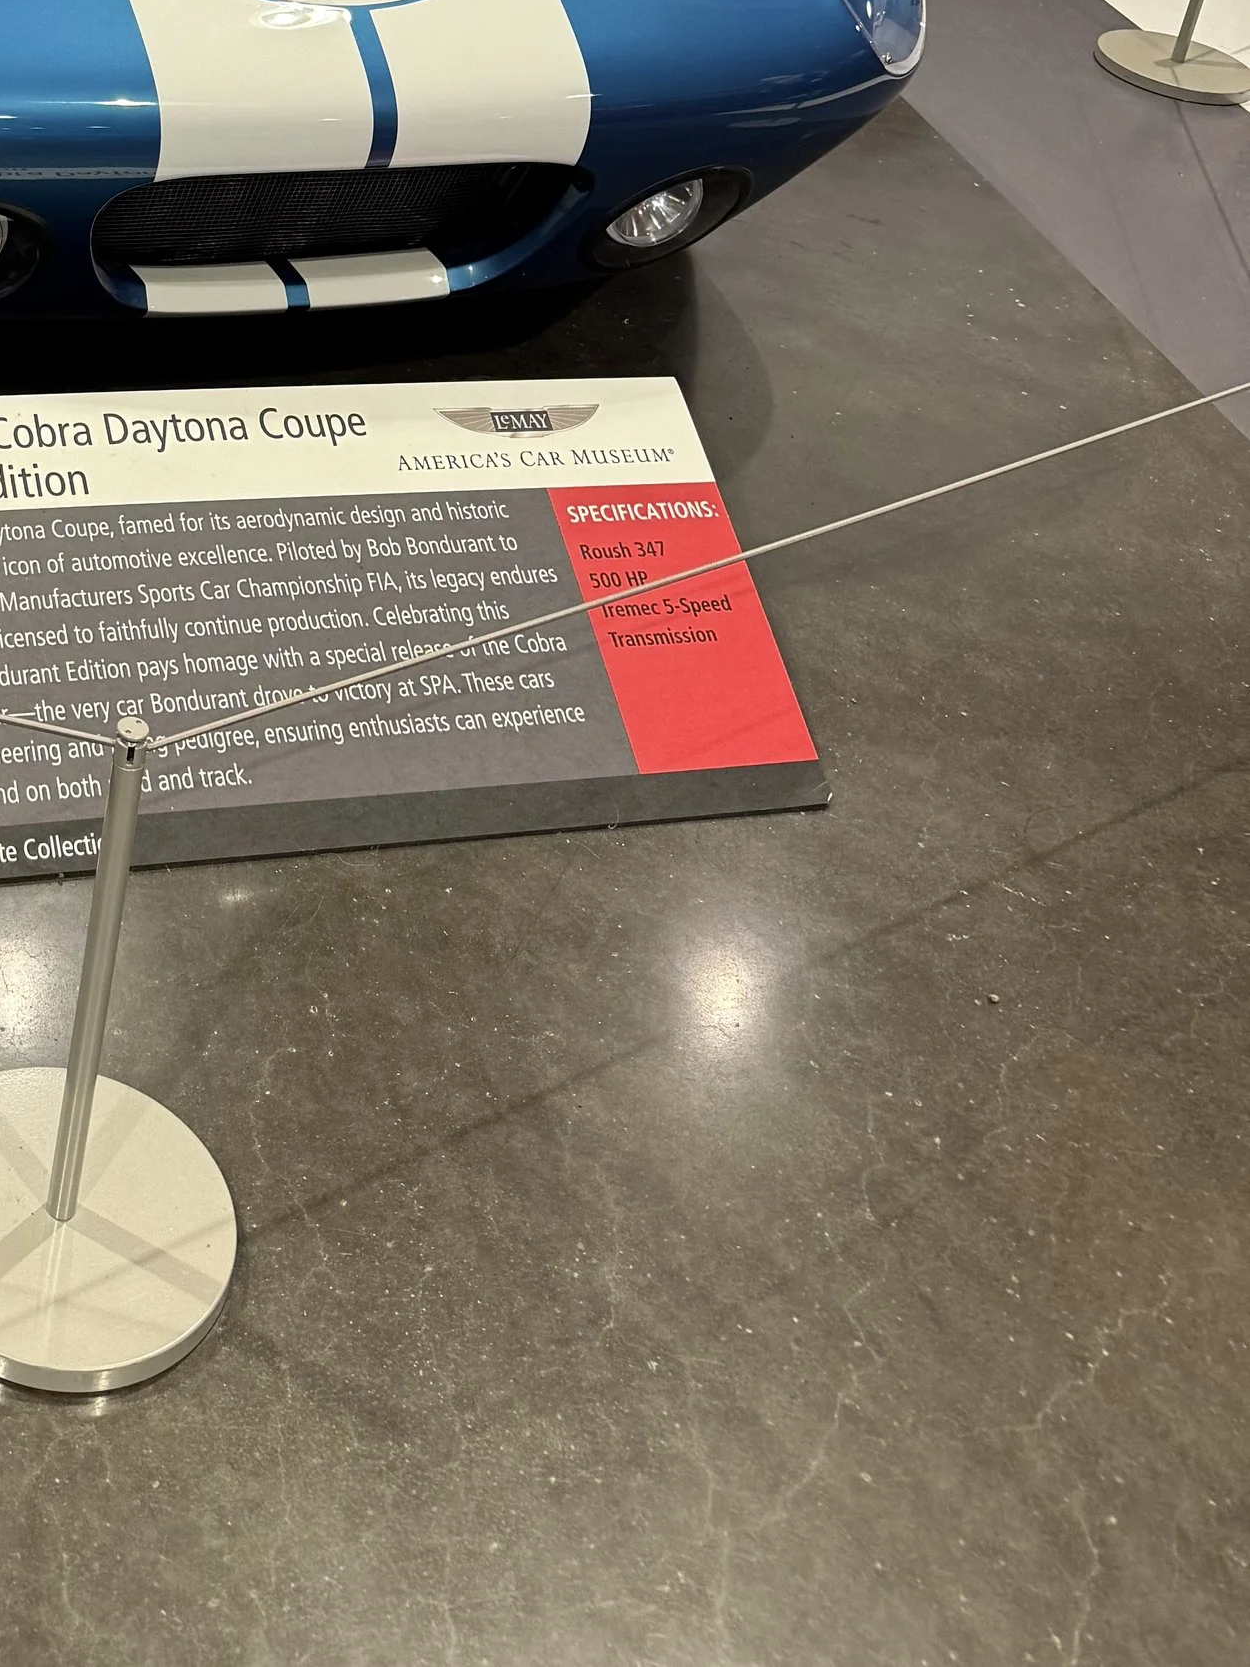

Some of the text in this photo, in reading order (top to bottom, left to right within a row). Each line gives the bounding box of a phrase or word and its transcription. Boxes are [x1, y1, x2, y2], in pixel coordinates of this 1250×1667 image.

[102, 412, 250, 454] Daytona
[258, 406, 368, 447] Coupe
[519, 450, 566, 468] CAR
[50, 518, 115, 543] Coupe,
[117, 512, 176, 536] famed
[178, 511, 205, 533] for
[208, 511, 232, 531] its
[235, 506, 348, 533] aerodynamic
[349, 503, 407, 529] design
[410, 500, 444, 523] and
[444, 499, 511, 521] historic
[566, 500, 720, 524] SPECIFICATIONS:
[1, 555, 42, 577] icon
[46, 551, 65, 574] of
[71, 548, 173, 573] automotive
[177, 543, 274, 567] excellence.
[275, 538, 339, 562] Piloted
[339, 537, 362, 564] by
[365, 536, 403, 558] Bob
[404, 533, 497, 556] Bondurant
[497, 534, 519, 552] to
[579, 540, 664, 560] Roush 347
[136, 583, 196, 609] Sports
[199, 579, 231, 601] Car
[236, 572, 363, 602] Championship
[365, 571, 403, 594] FIA,
[403, 569, 428, 591] its
[428, 567, 485, 594] legacy
[489, 563, 559, 586] endures
[588, 570, 648, 589] 500 HP
[72, 624, 94, 645] to
[97, 616, 179, 644] faithfully
[183, 614, 263, 638] continue
[266, 608, 370, 639] production.
[372, 602, 475, 628] Celebrating
[475, 599, 511, 622] this
[662, 593, 733, 618] 5-Speed
[65, 657, 132, 682] Edition
[135, 658, 180, 684] pays
[182, 651, 259, 677] homage
[261, 645, 305, 670] with
[308, 650, 322, 667] a
[324, 640, 388, 671] special
[481, 639, 511, 657] the
[513, 631, 568, 654] Cobra
[607, 625, 718, 648] Transmission
[70, 700, 110, 724] very
[115, 698, 145, 715] car
[149, 688, 250, 715] Bondurant
[334, 682, 392, 705] victory
[397, 677, 418, 698] at
[419, 673, 462, 697] SPA.
[460, 670, 516, 694] These
[518, 671, 556, 690] cars
[263, 718, 345, 746] ensuring
[348, 712, 451, 739] enthusiasts
[454, 712, 488, 731] can
[491, 703, 587, 733] experience
[25, 783, 52, 803] on
[55, 773, 103, 800] both
[157, 765, 195, 792] and
[197, 761, 253, 789] track.
[22, 832, 102, 861] Collecti
